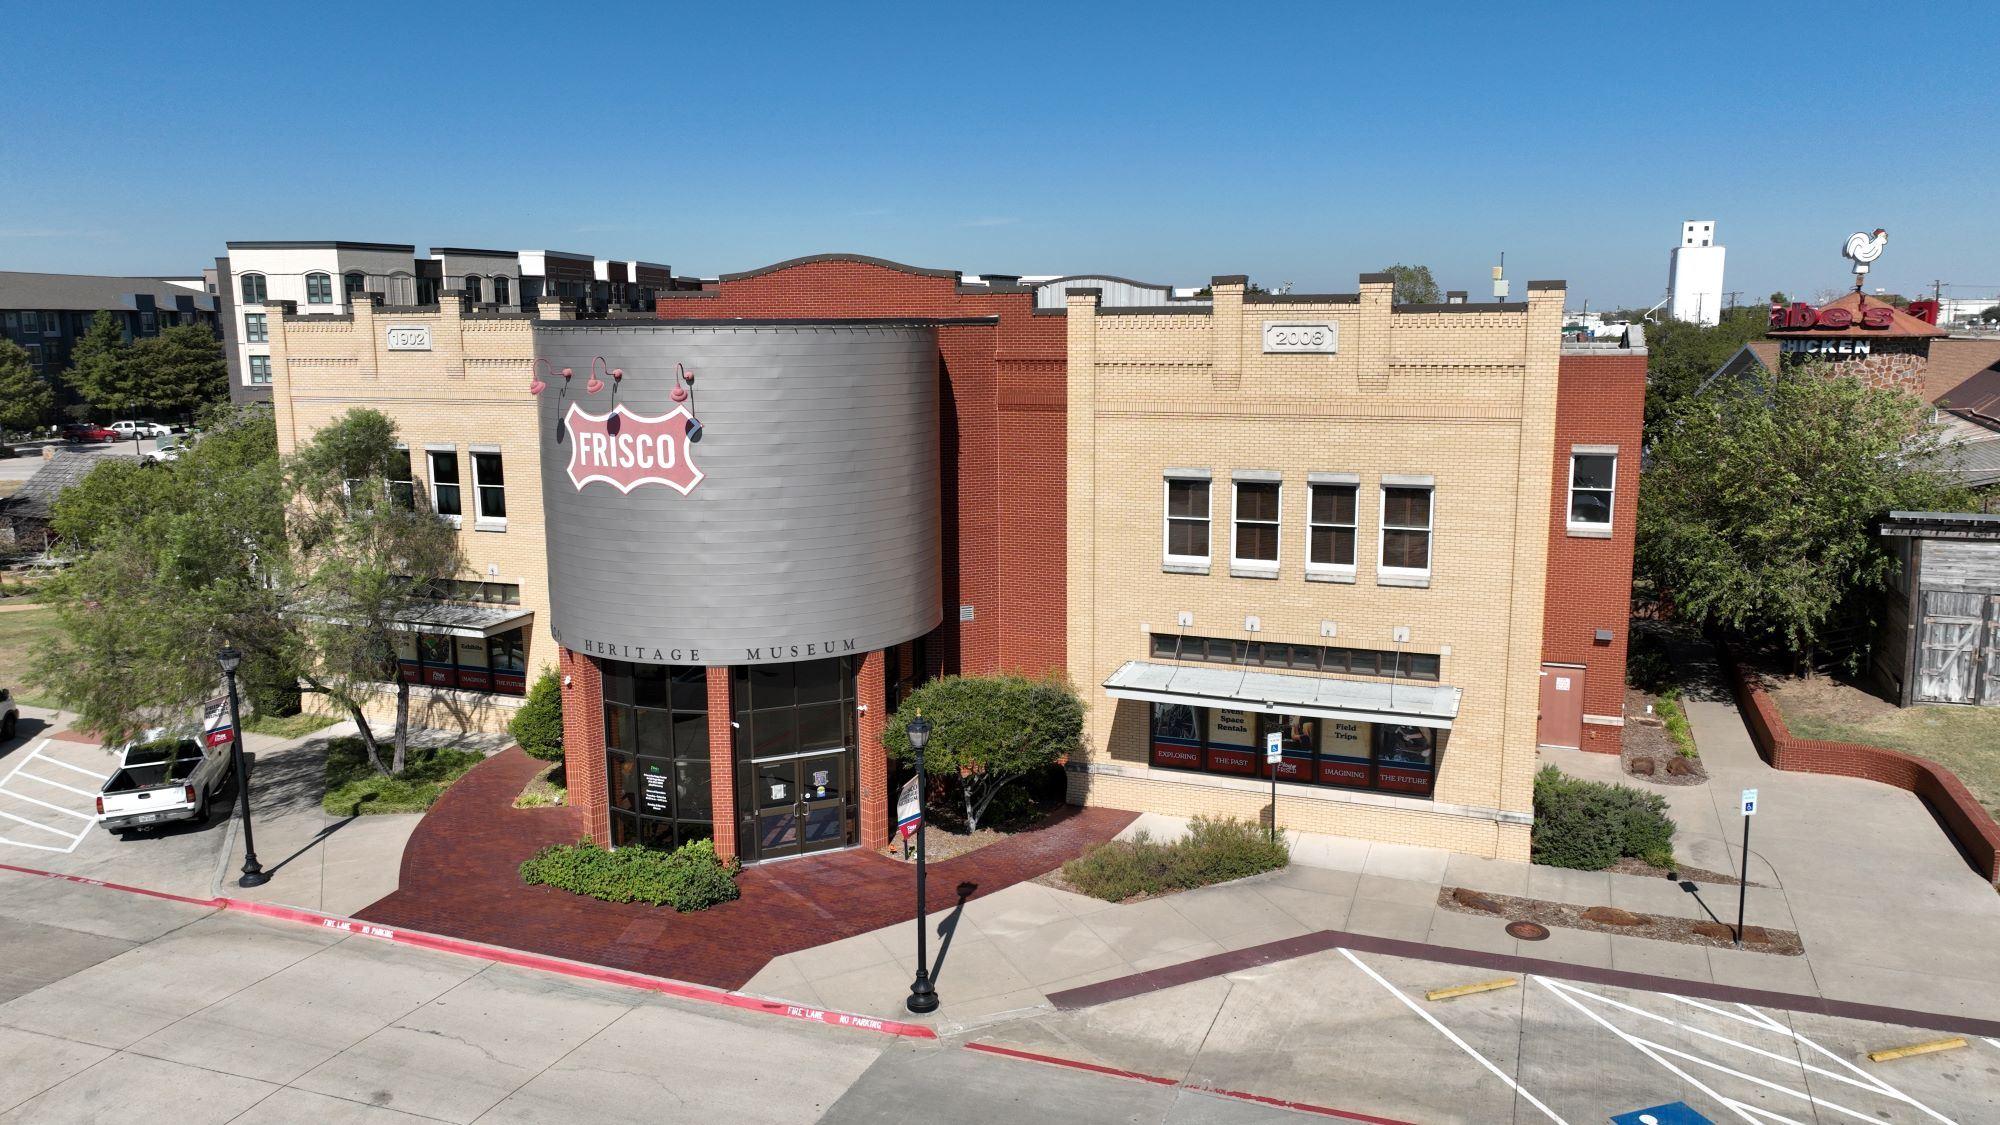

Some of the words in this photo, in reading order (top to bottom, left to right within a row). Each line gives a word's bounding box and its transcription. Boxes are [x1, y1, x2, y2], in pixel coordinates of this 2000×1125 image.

[1769, 302, 1894, 328] abe's
[392, 333, 425, 346] 1902
[1275, 331, 1325, 346] 2008
[1780, 339, 1871, 354] CHICKEN
[579, 431, 676, 469] FRISCO
[585, 639, 700, 662] HERITAGE
[746, 638, 856, 661] MUSEUM
[1220, 715, 1244, 724] Space
[1217, 723, 1248, 733] Rentals
[1335, 723, 1357, 732] Field
[1334, 732, 1358, 740] Trips
[1158, 750, 1197, 761] EXPLORING
[1230, 758, 1249, 767] PAST
[1324, 768, 1365, 779] IMAGINING
[1380, 774, 1397, 783] THE
[1398, 776, 1428, 785] FUTURE
[787, 1006, 804, 1017] FIRE
[805, 1009, 824, 1020] LANE
[839, 1015, 850, 1024] NO
[852, 1017, 883, 1030] PARKING
